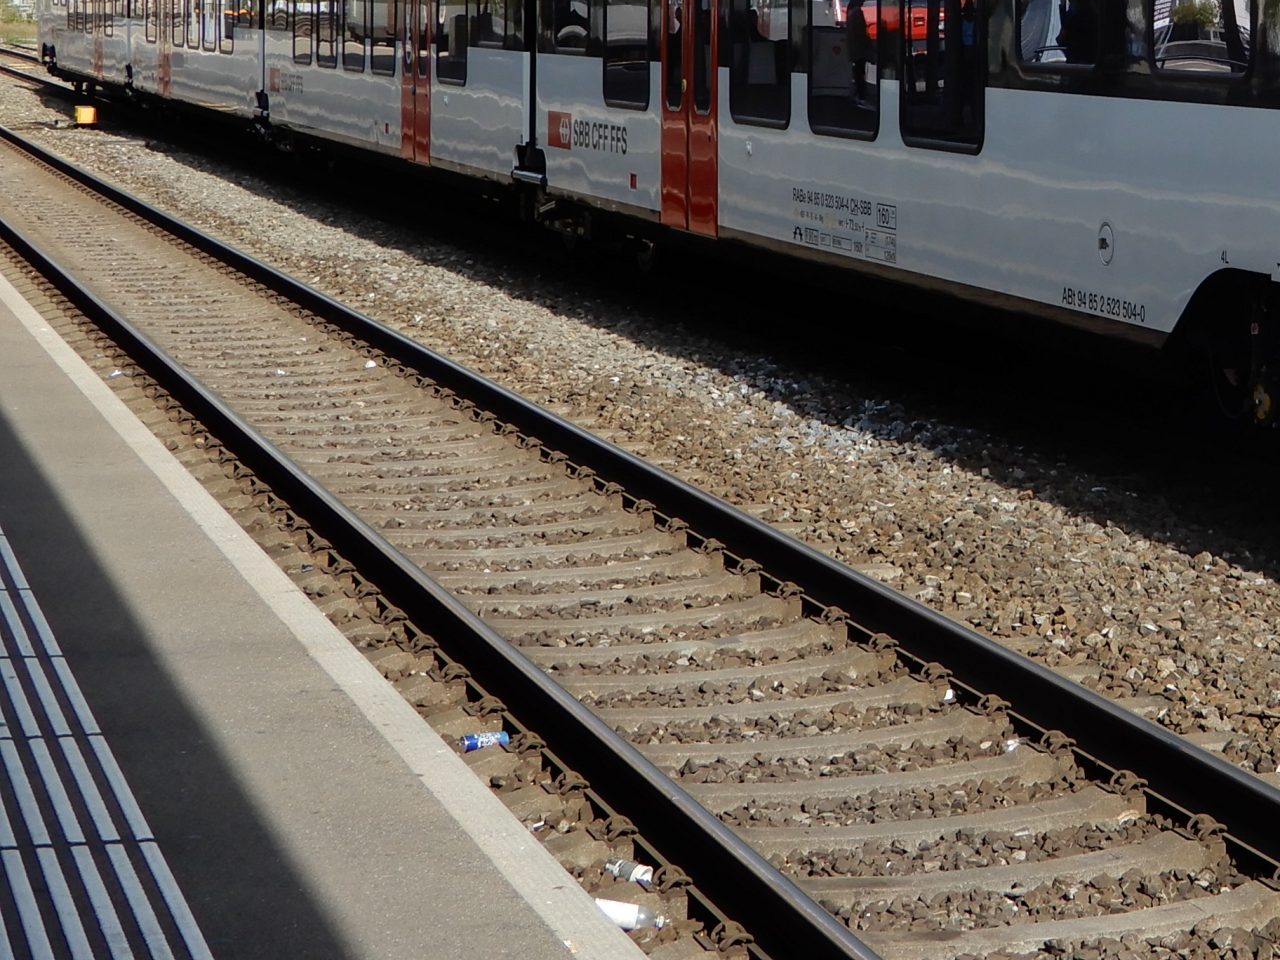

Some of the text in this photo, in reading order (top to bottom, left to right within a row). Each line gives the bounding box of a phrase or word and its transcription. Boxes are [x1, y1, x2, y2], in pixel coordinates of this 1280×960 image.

[573, 119, 628, 155] SBB CFF FFS
[1220, 250, 1229, 264] 4L
[1062, 287, 1146, 322] ABt 94 85 2 523 504-0
